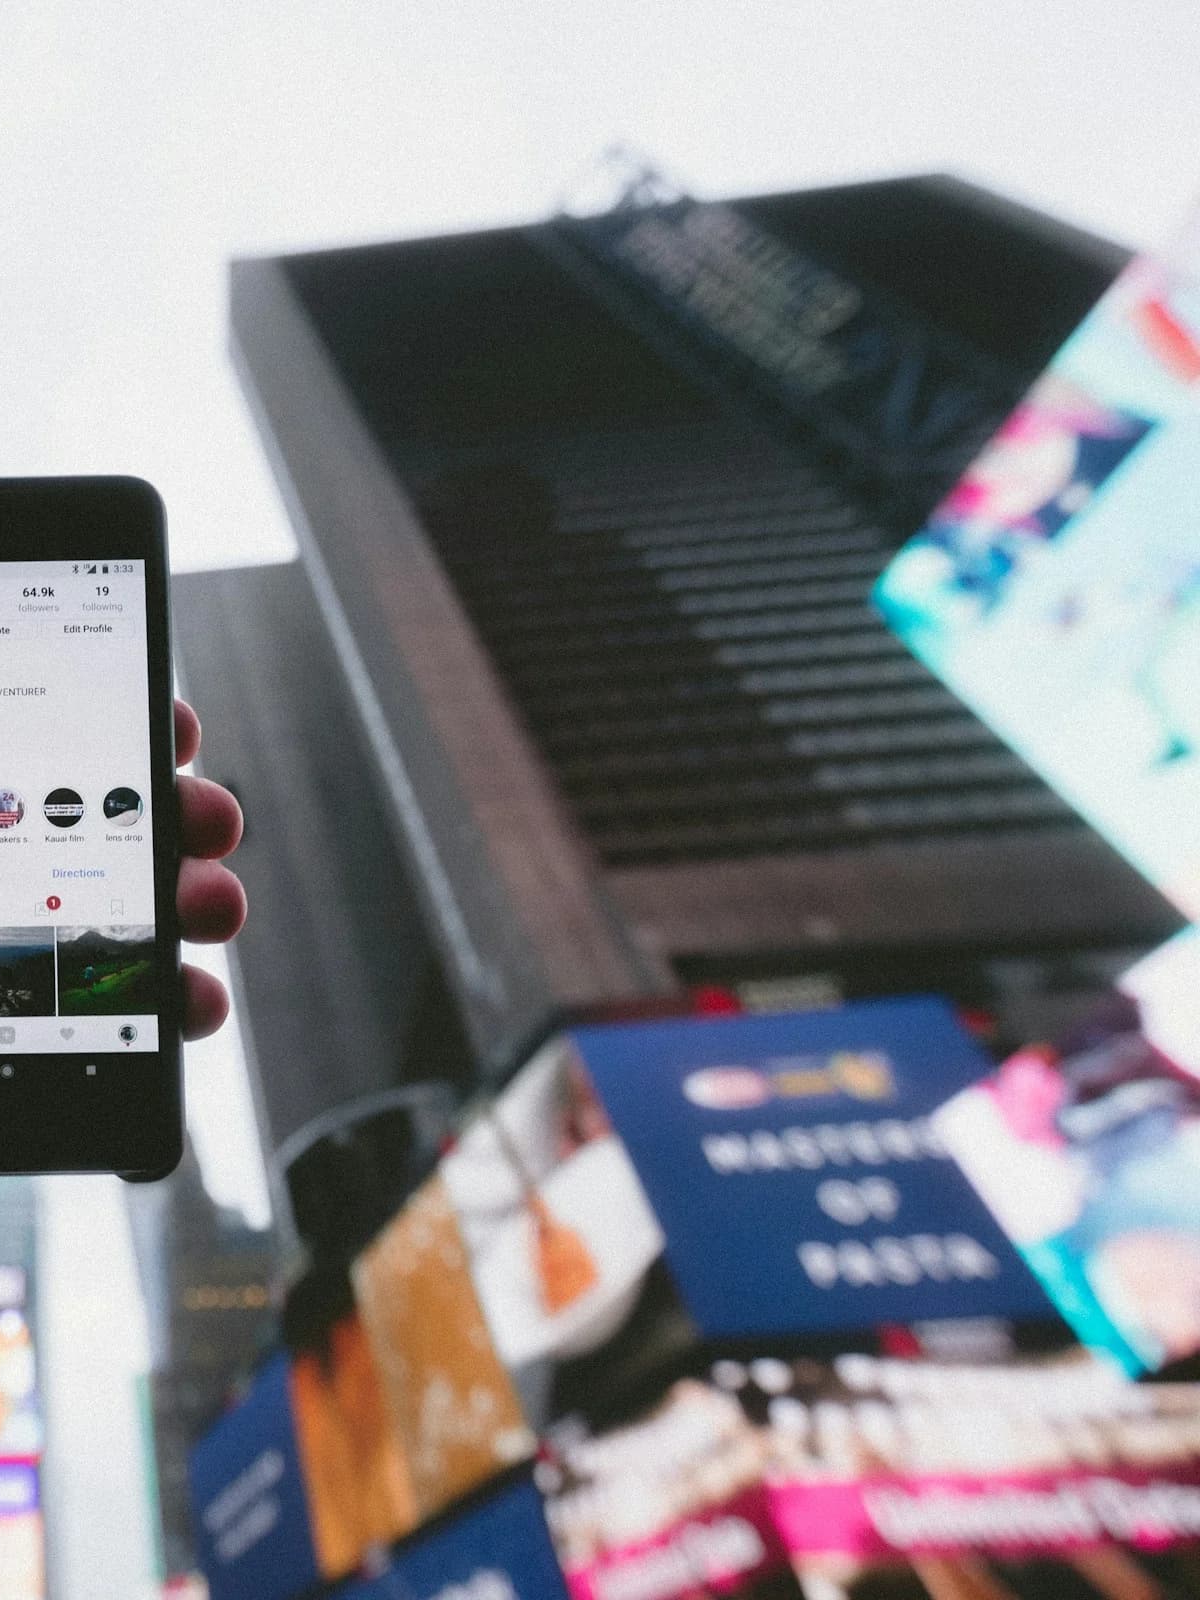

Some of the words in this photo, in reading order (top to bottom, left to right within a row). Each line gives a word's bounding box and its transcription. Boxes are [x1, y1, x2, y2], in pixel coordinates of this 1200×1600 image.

[113, 564, 134, 574] 3:33
[22, 587, 55, 598] 64.9k
[95, 586, 110, 596] 19
[18, 602, 60, 613] followers
[82, 601, 123, 614] following
[63, 625, 81, 634] Edit
[83, 624, 113, 634] Profile
[44, 834, 68, 843] Kauai
[69, 834, 85, 843] film
[105, 833, 123, 842] lens
[124, 833, 143, 843] drop
[52, 868, 105, 879] Directions
